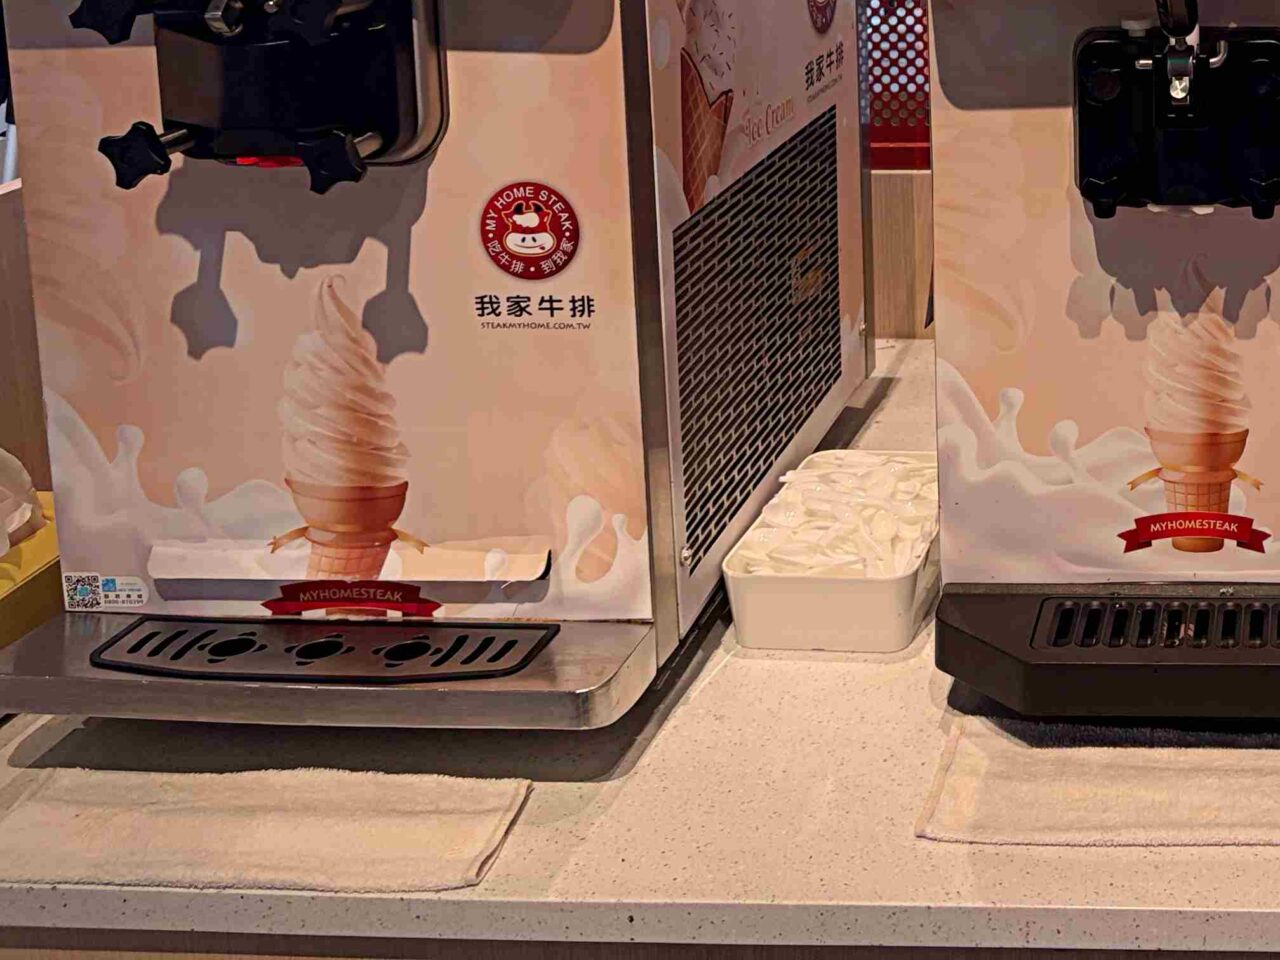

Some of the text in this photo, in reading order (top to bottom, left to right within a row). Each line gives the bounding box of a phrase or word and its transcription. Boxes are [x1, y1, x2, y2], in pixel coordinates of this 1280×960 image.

[485, 187, 573, 231] MY HOME STEAK
[487, 238, 574, 274] 吃牛排 到我家
[475, 295, 595, 318] 我家牛排
[481, 322, 591, 330] STEAKMYHOME.COM.TW
[1150, 520, 1238, 533] MYHOMESTEAK
[300, 588, 403, 602] MYHOMESTEAK
